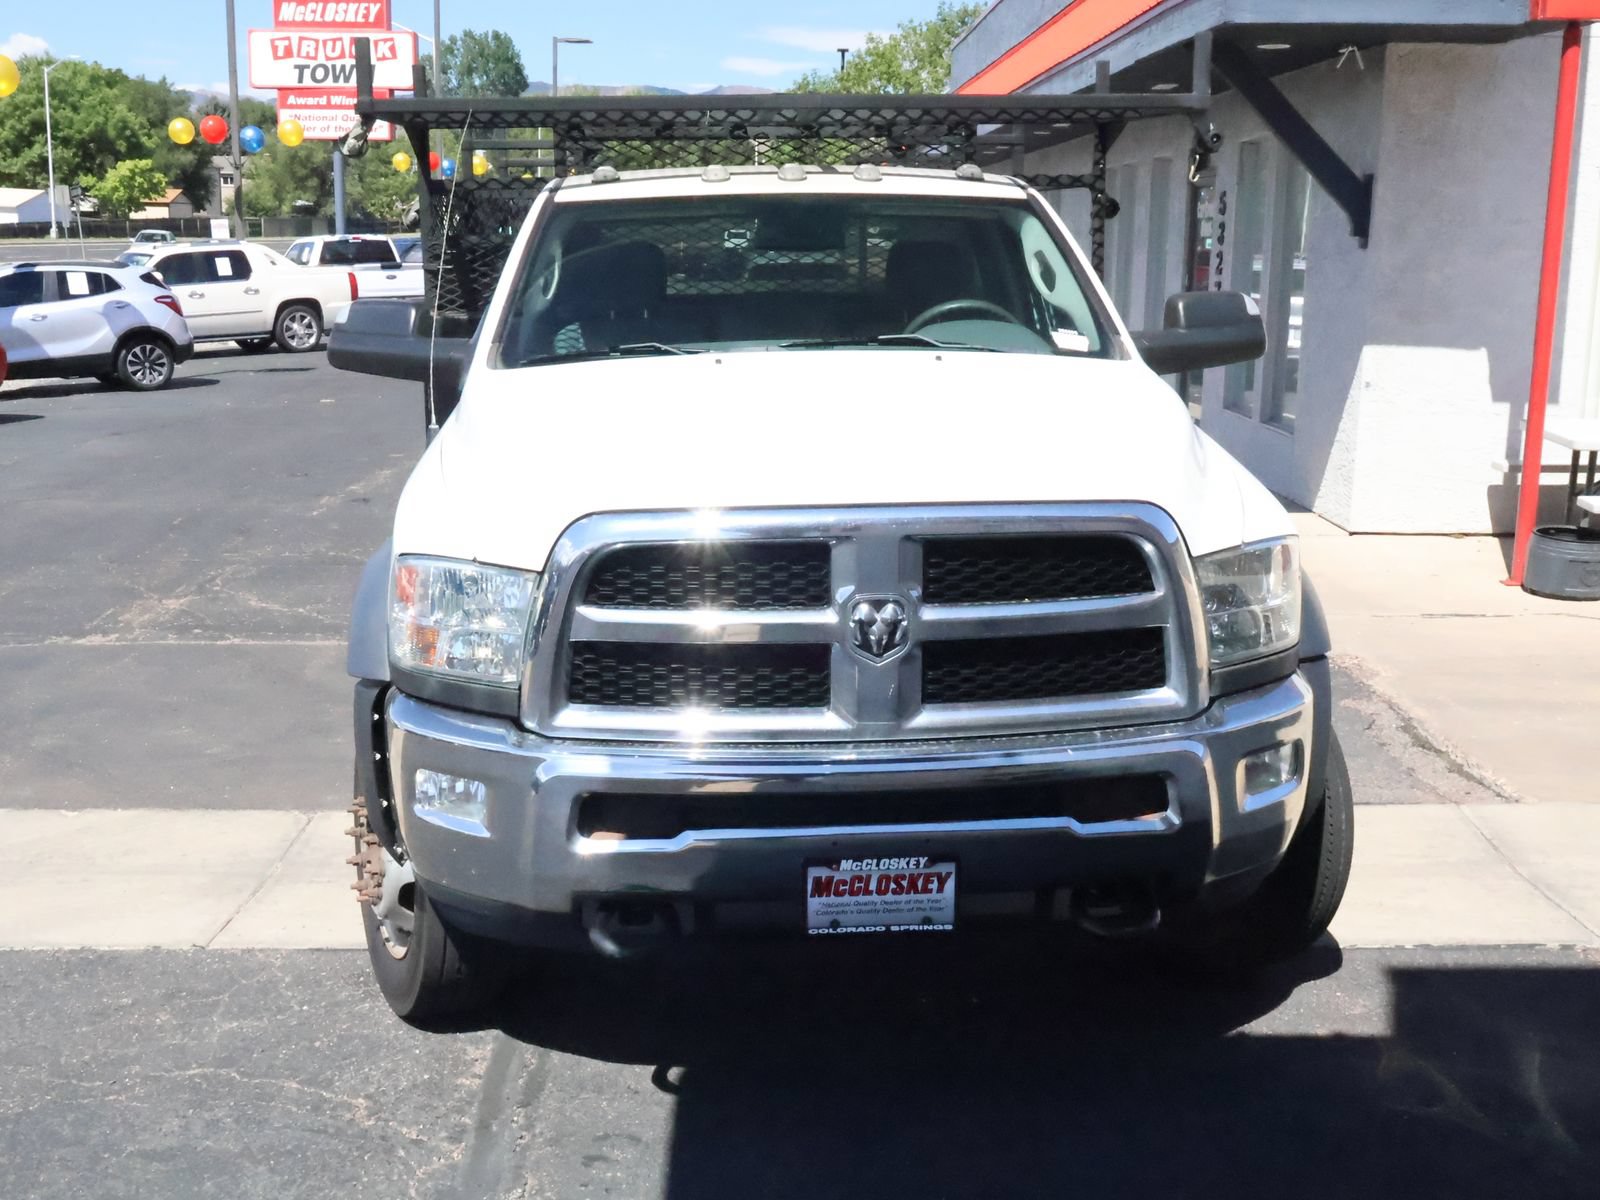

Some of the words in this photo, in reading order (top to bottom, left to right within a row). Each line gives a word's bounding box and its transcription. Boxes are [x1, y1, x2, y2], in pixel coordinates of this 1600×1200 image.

[279, 2, 381, 23] McCLOSKEY
[274, 39, 394, 58] TRUK
[293, 63, 376, 84] TOW
[287, 95, 327, 105] Award
[320, 124, 330, 132] of
[839, 857, 928, 871] McCLOSKEY
[809, 871, 953, 898] McCLOSKEY
[808, 925, 886, 935] COLORADO
[890, 924, 954, 932] SPRINGS
